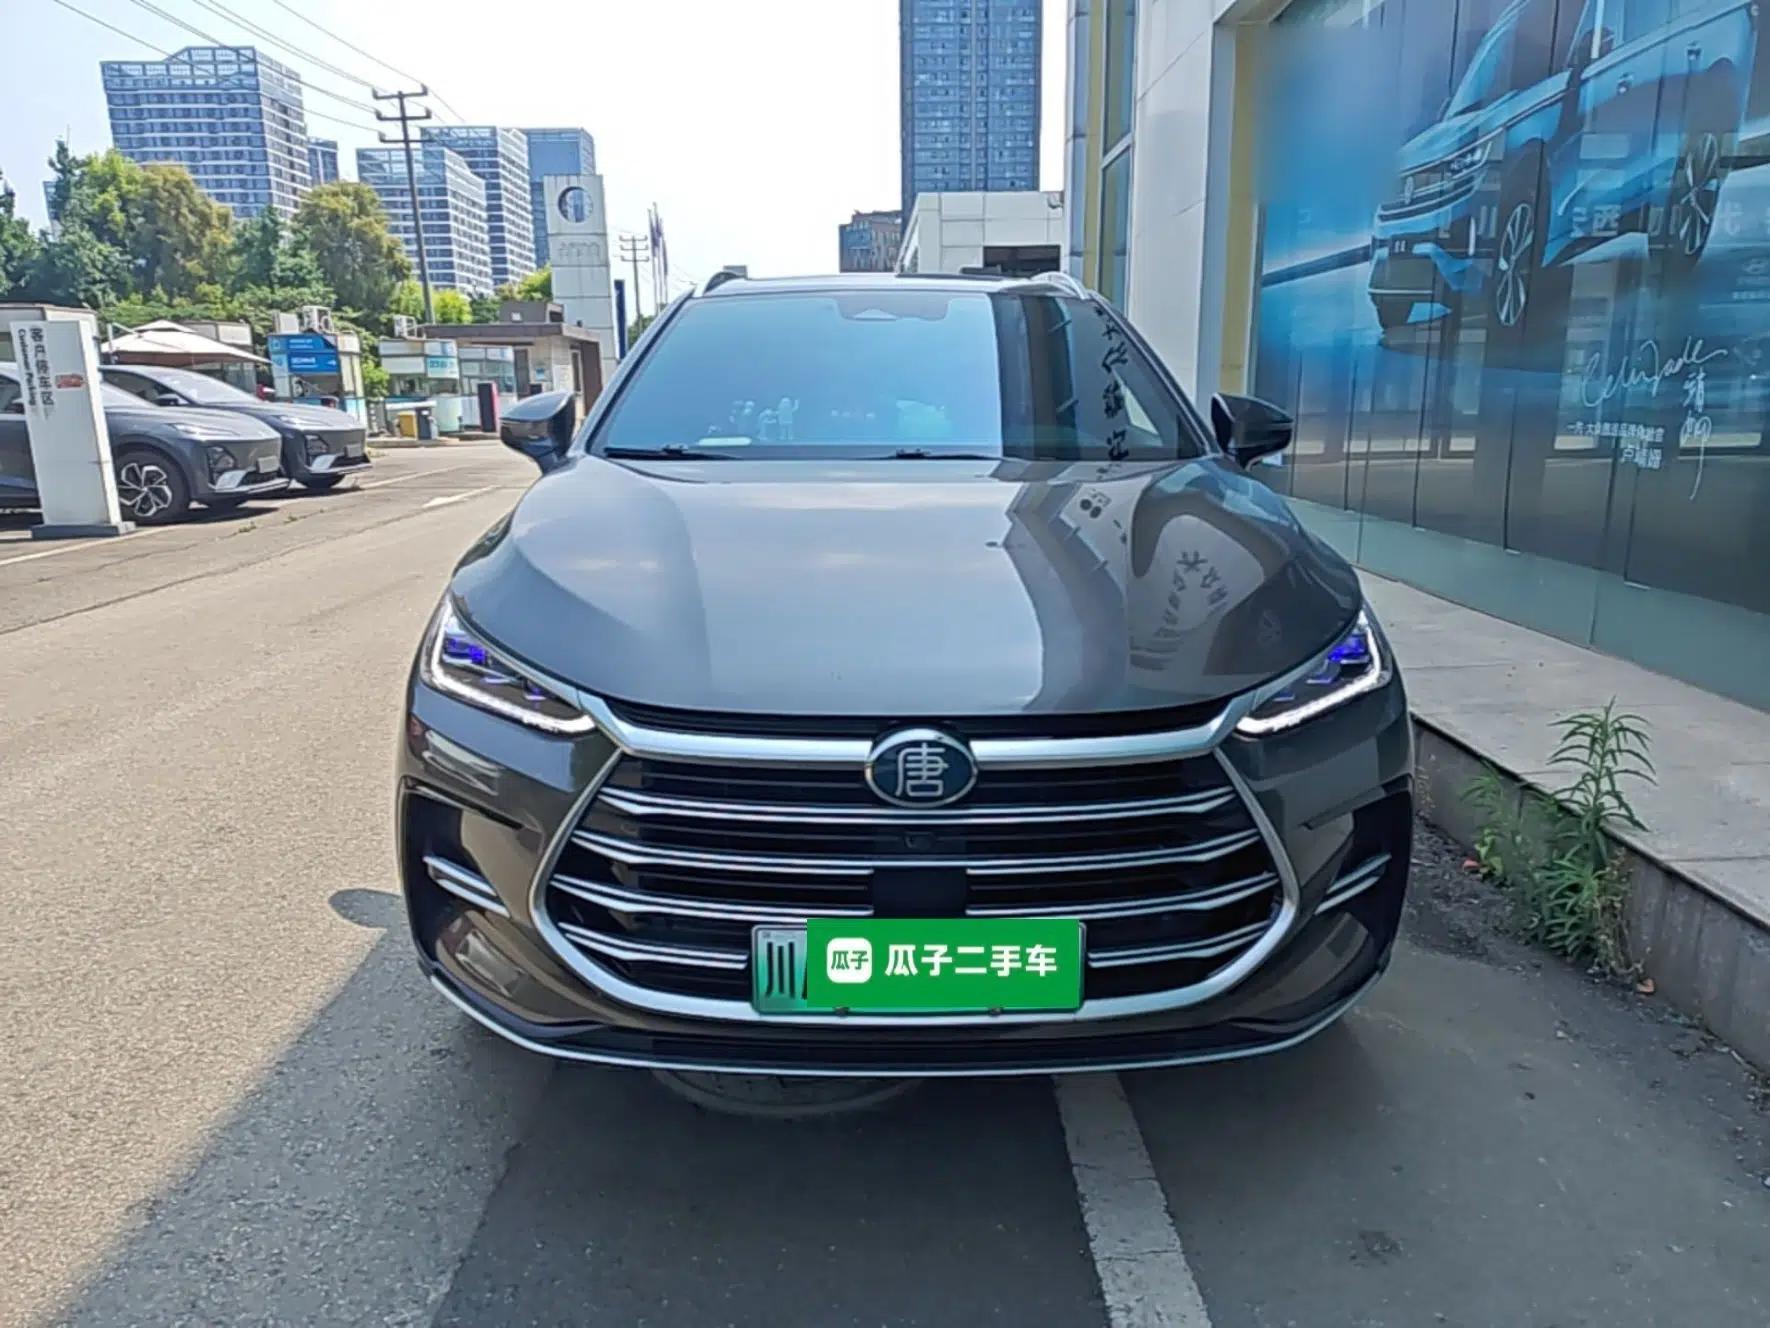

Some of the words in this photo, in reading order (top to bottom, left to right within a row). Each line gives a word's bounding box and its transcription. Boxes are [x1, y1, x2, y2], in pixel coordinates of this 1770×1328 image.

[18, 328, 30, 371] Customer
[25, 372, 36, 406] Parking
[895, 742, 949, 797] 唐
[764, 941, 808, 1000] 川
